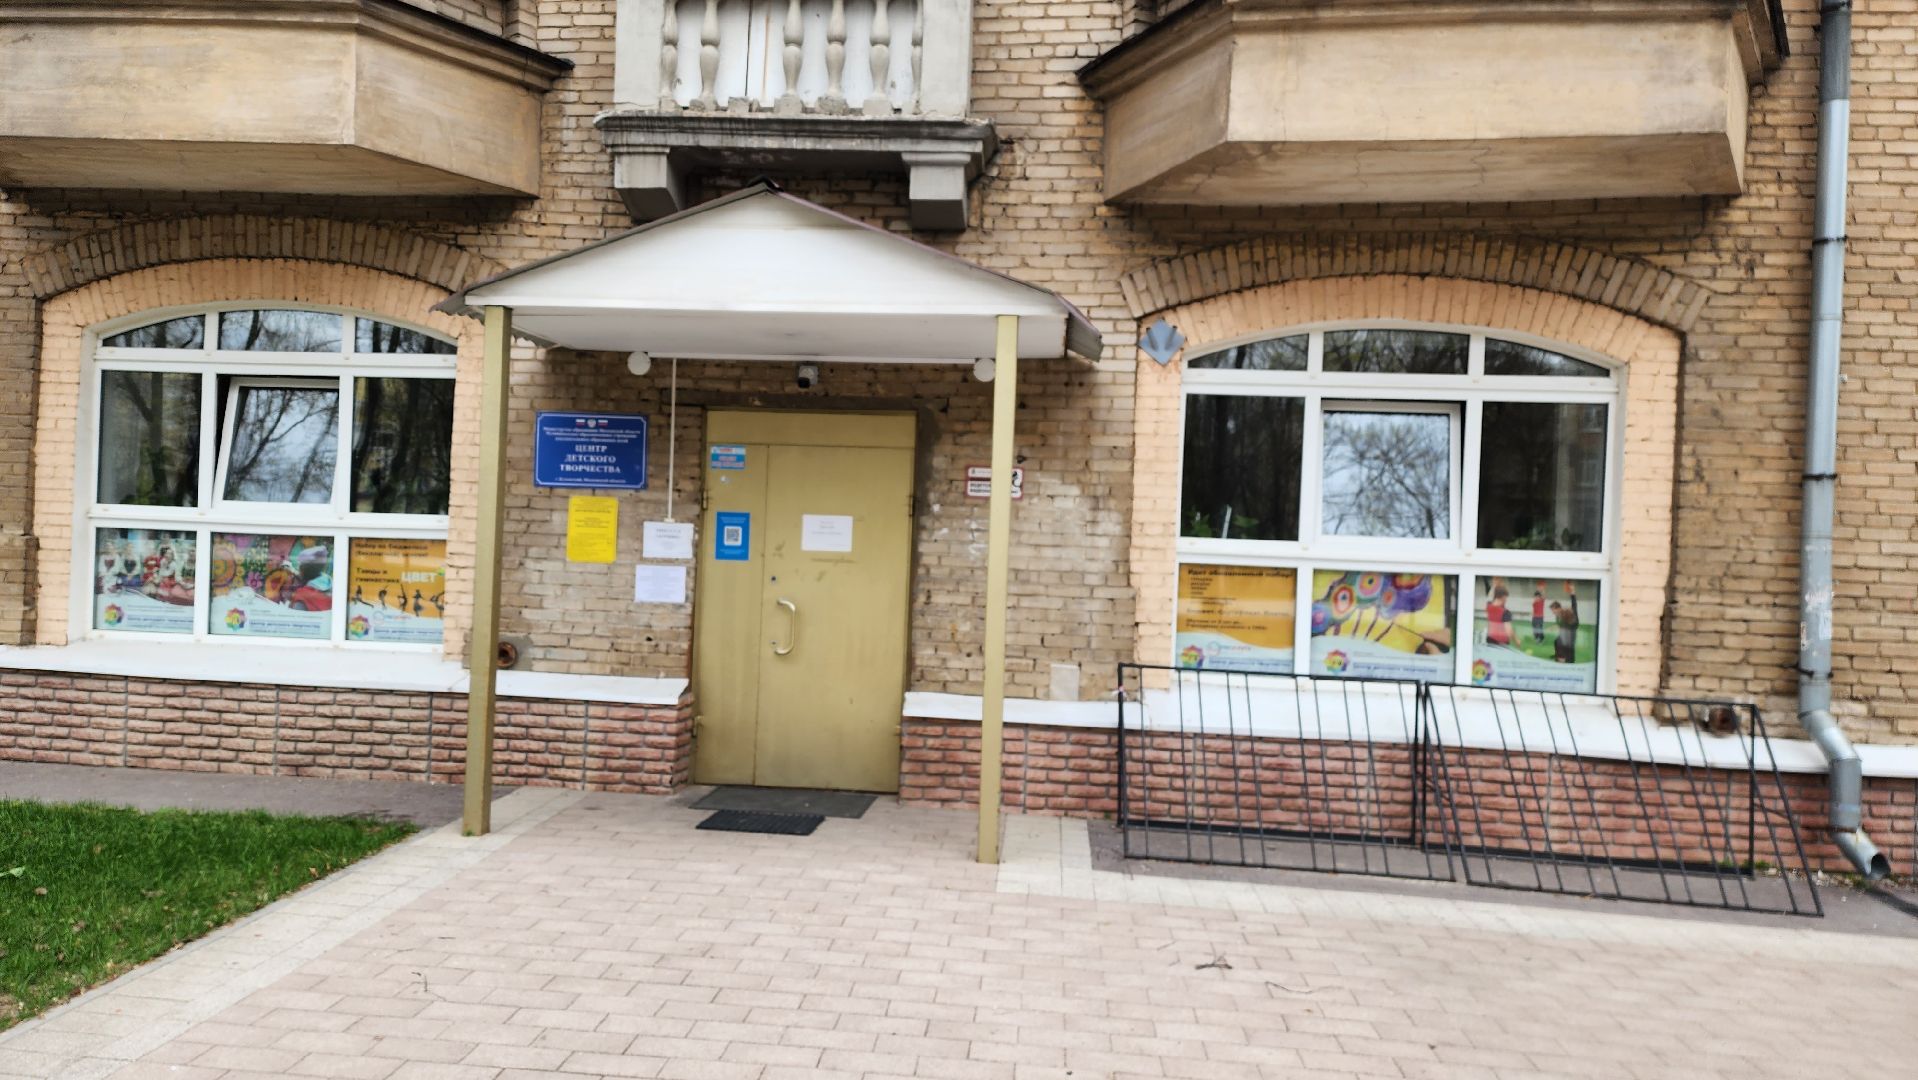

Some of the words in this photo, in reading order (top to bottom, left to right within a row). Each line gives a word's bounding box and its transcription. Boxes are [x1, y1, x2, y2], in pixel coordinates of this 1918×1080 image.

[576, 445, 607, 453] ЦЕНТР
[565, 454, 616, 463] ДЕТСКОГО
[560, 464, 620, 473] ТВОРЧЕСТВА
[401, 572, 436, 583] ЦВЕТ
